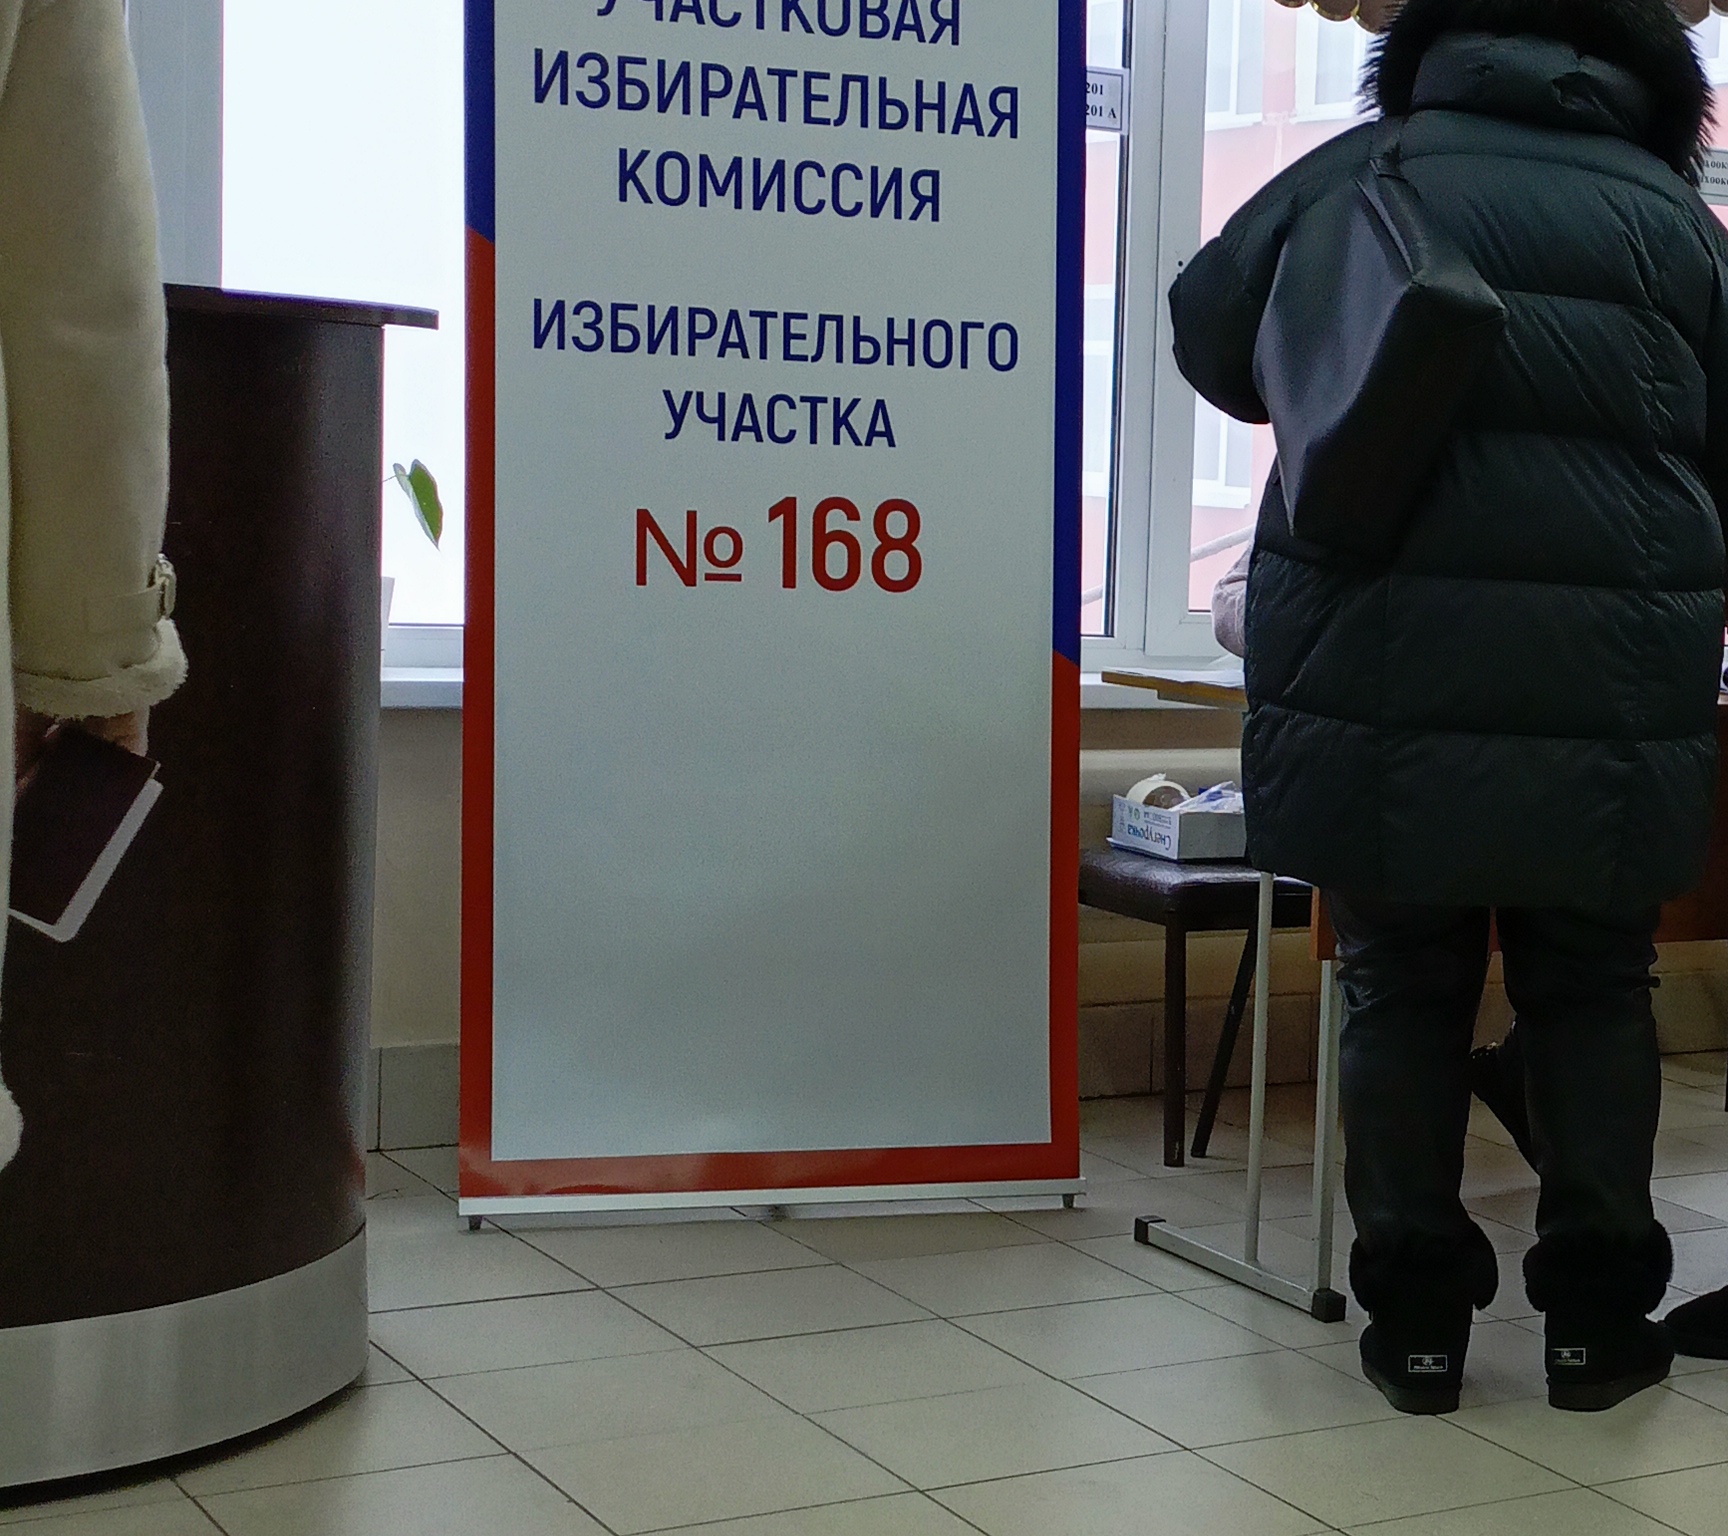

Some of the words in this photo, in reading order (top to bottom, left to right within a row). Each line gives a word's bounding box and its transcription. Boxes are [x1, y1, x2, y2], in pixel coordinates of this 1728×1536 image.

[534, 47, 1019, 140] ИЗБИРАТЕЛЬНАЯ
[618, 147, 940, 223] КОМИССИЯ
[533, 297, 1019, 373] ИЗБИРАТЕЛЬНОГО
[662, 388, 897, 448] УЧАСТКА
[636, 508, 743, 587] №
[768, 496, 923, 593] 168
